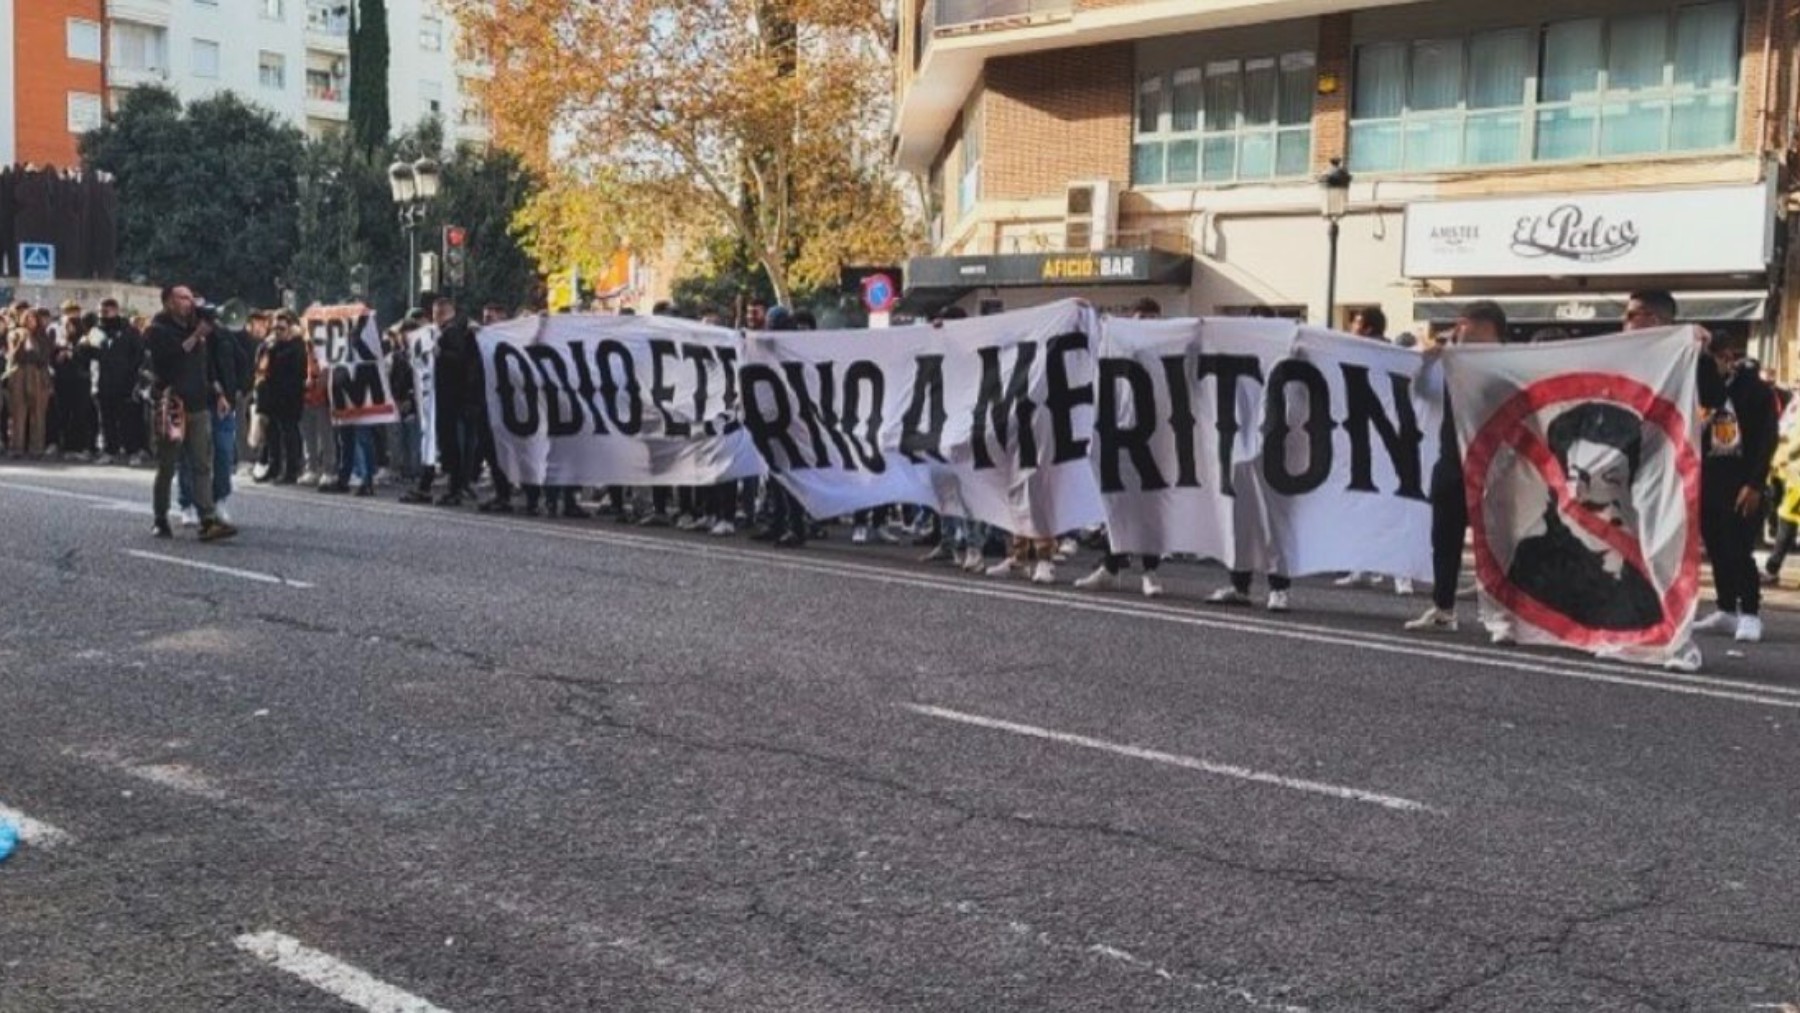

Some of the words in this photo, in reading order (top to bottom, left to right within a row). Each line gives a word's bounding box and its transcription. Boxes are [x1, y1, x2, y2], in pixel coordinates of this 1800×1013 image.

[1512, 214, 1541, 247] El
[1547, 204, 1639, 251] Palco
[1100, 255, 1134, 276] BAR
[307, 315, 379, 364] FCK
[331, 363, 387, 410] M
[494, 340, 643, 437] ODIO
[899, 354, 949, 464] A
[971, 331, 1431, 503] MERITON
